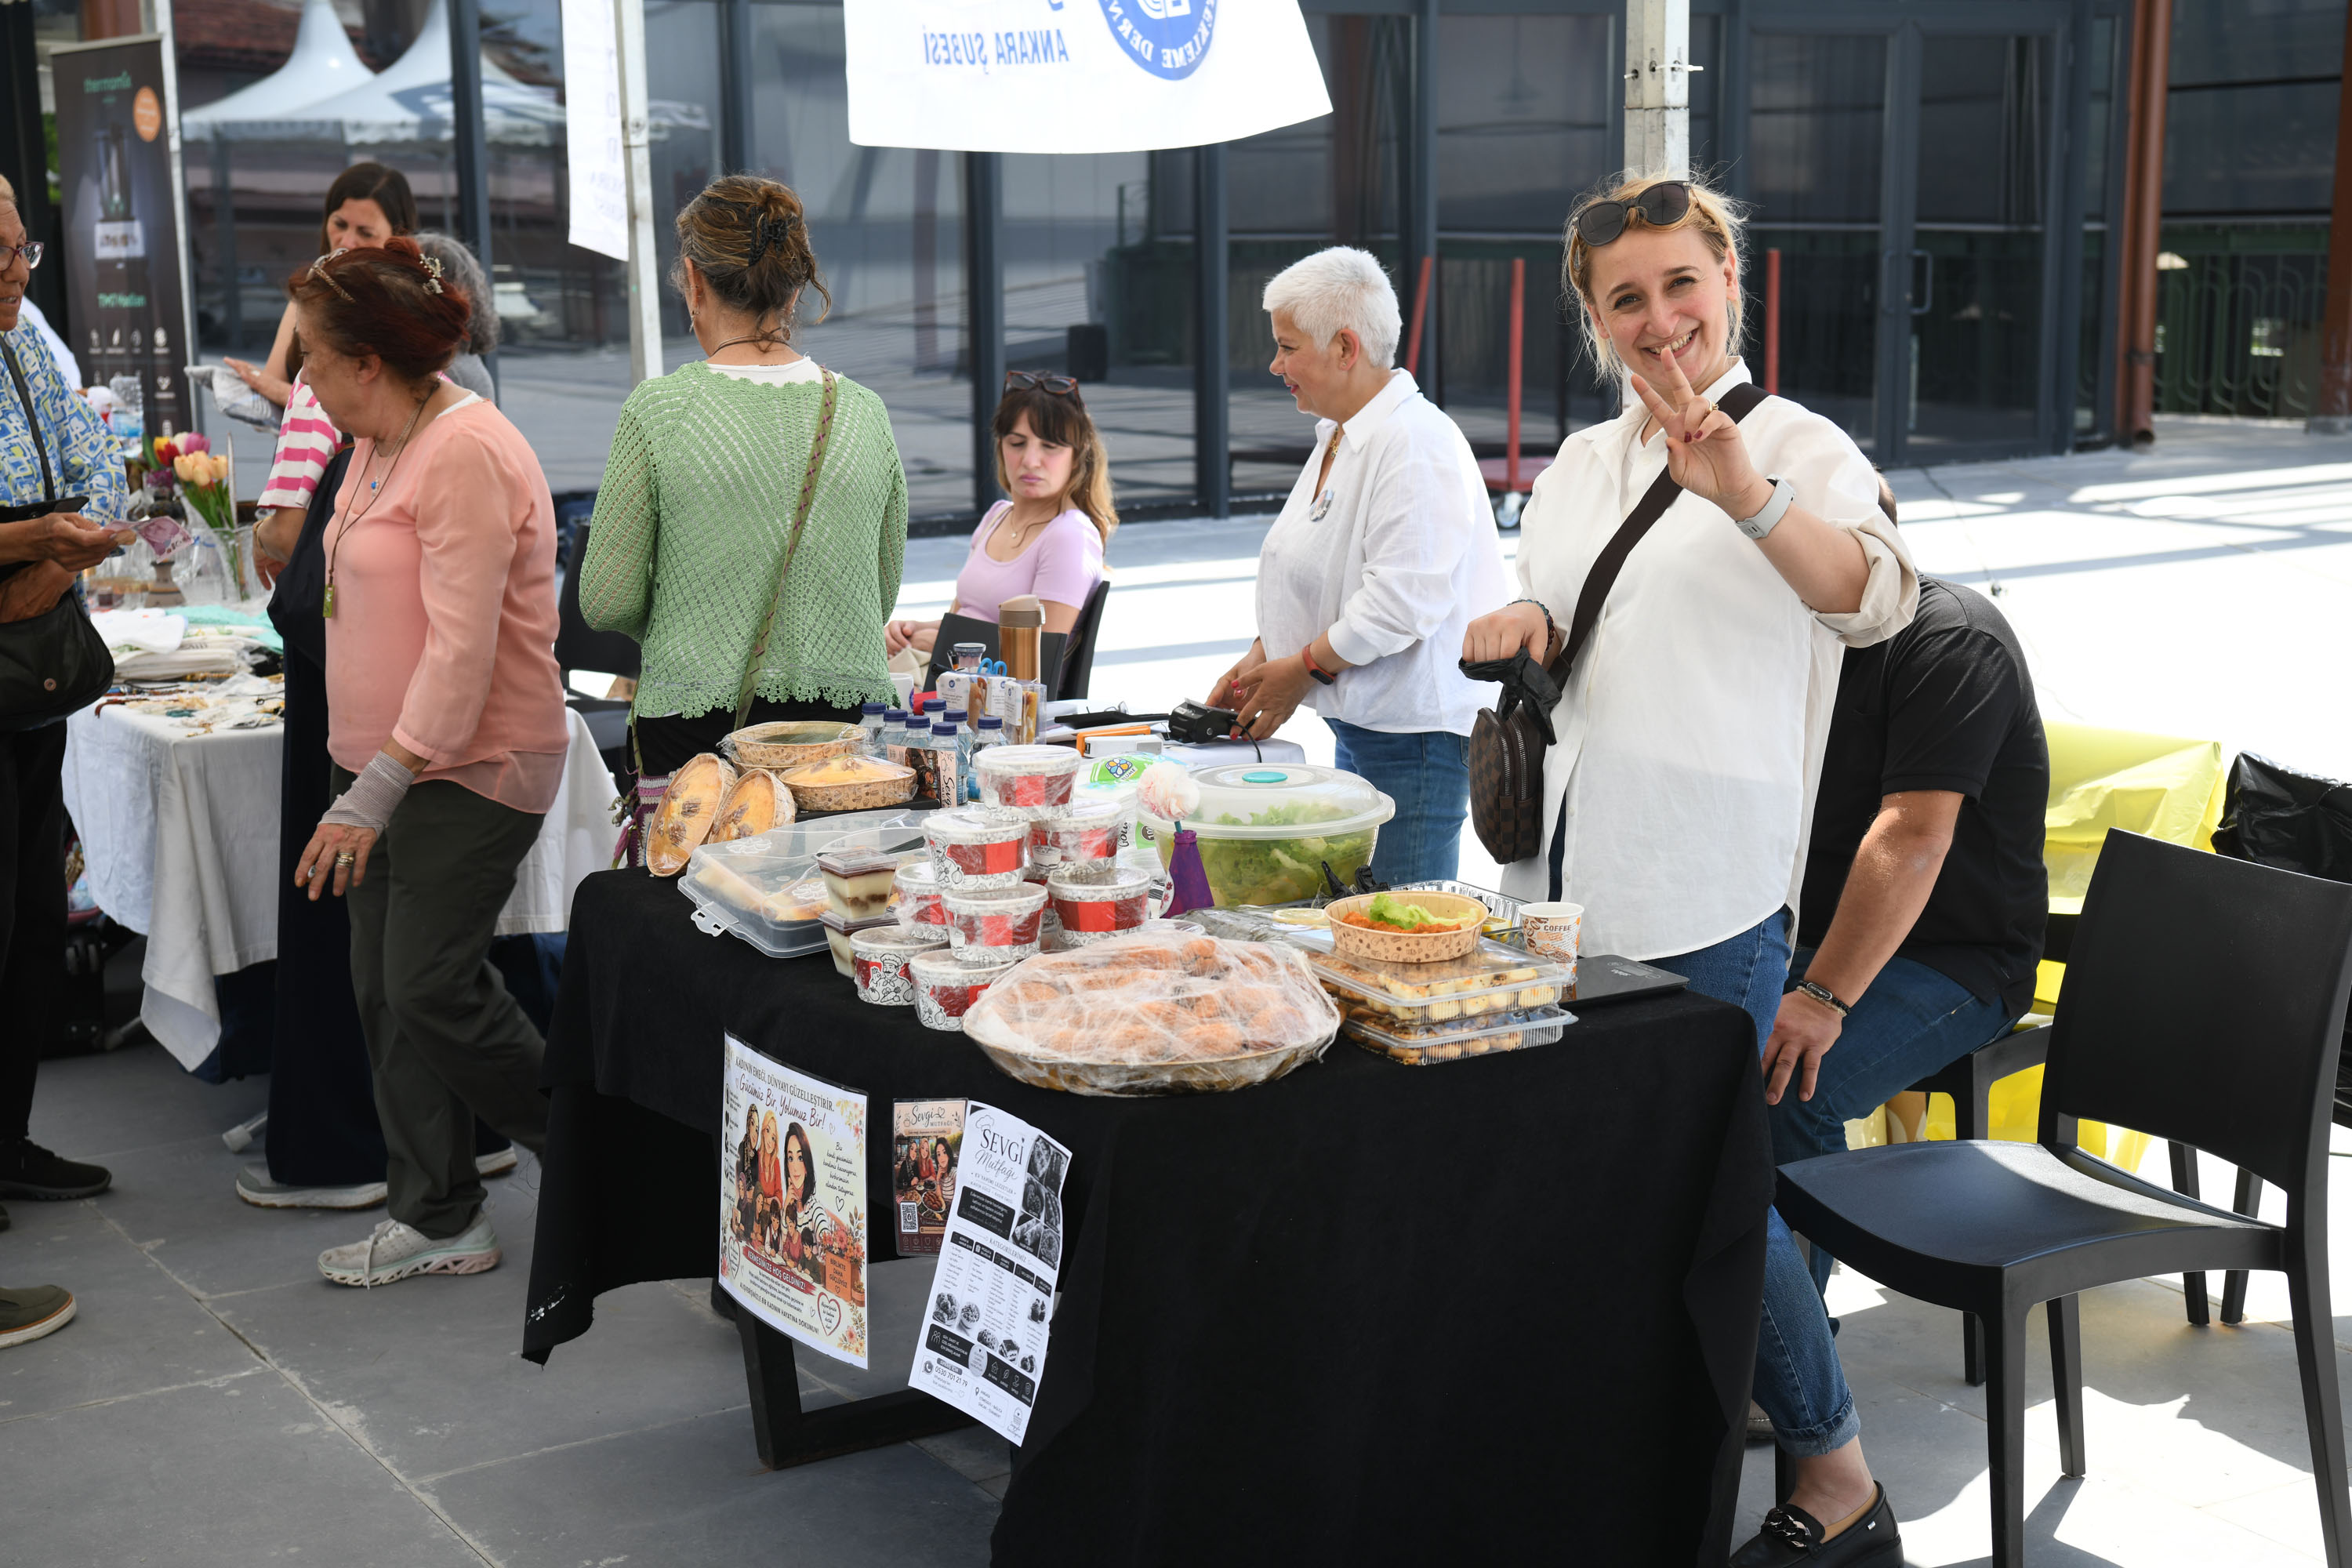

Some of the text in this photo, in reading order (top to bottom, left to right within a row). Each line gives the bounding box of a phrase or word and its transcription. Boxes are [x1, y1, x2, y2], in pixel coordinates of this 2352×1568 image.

[942, 775, 955, 808] Sevg
[739, 1073, 764, 1102] Gücümüz
[765, 1087, 778, 1111] Bir,
[779, 1094, 808, 1121] Yolumuz
[808, 1107, 826, 1130] Bir!
[753, 1066, 768, 1083] EMEĞİ,
[768, 1074, 789, 1094] DÜNYAYI
[789, 1084, 835, 1112] GÜZELLEŞTİRİR.
[911, 1105, 935, 1128] Sevgi
[980, 1128, 1025, 1165] SEVGİ
[975, 1149, 1018, 1182] Mutfağı
[772, 1266, 782, 1279] HOŞ
[782, 1272, 806, 1291] GELDİNİZ!
[830, 1258, 846, 1271] BİRLİKTE
[833, 1269, 844, 1277] DAHA
[767, 1299, 781, 1314] KADININ
[781, 1308, 798, 1324] HAYATINA
[798, 1318, 819, 1334] DOKUNUN!
[935, 1366, 947, 1377] 0530
